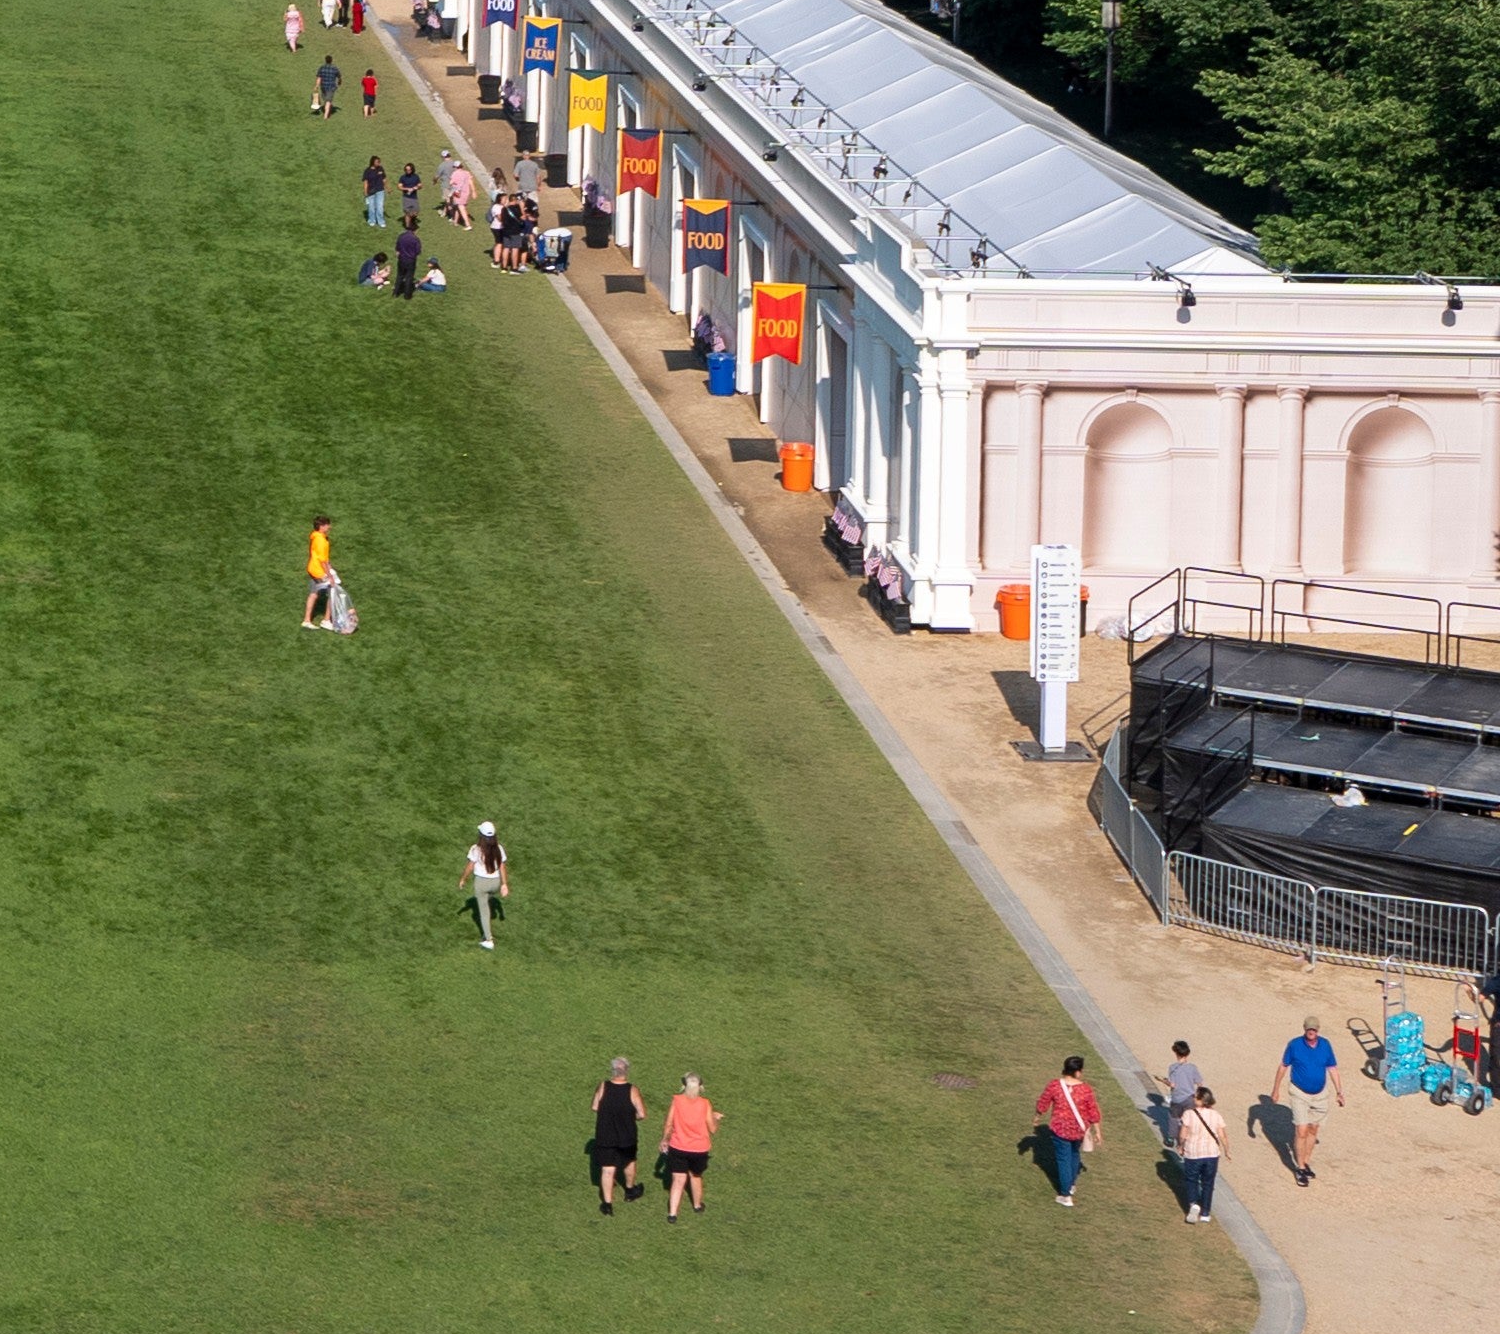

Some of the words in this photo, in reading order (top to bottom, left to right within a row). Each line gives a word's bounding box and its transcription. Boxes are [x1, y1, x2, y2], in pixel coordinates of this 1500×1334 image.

[533, 37, 548, 49] ICE
[525, 48, 556, 61] CREAM
[572, 96, 604, 112] FOOD
[623, 156, 657, 175] FOOD
[687, 231, 725, 250] FOOD
[757, 317, 798, 338] FOOD
